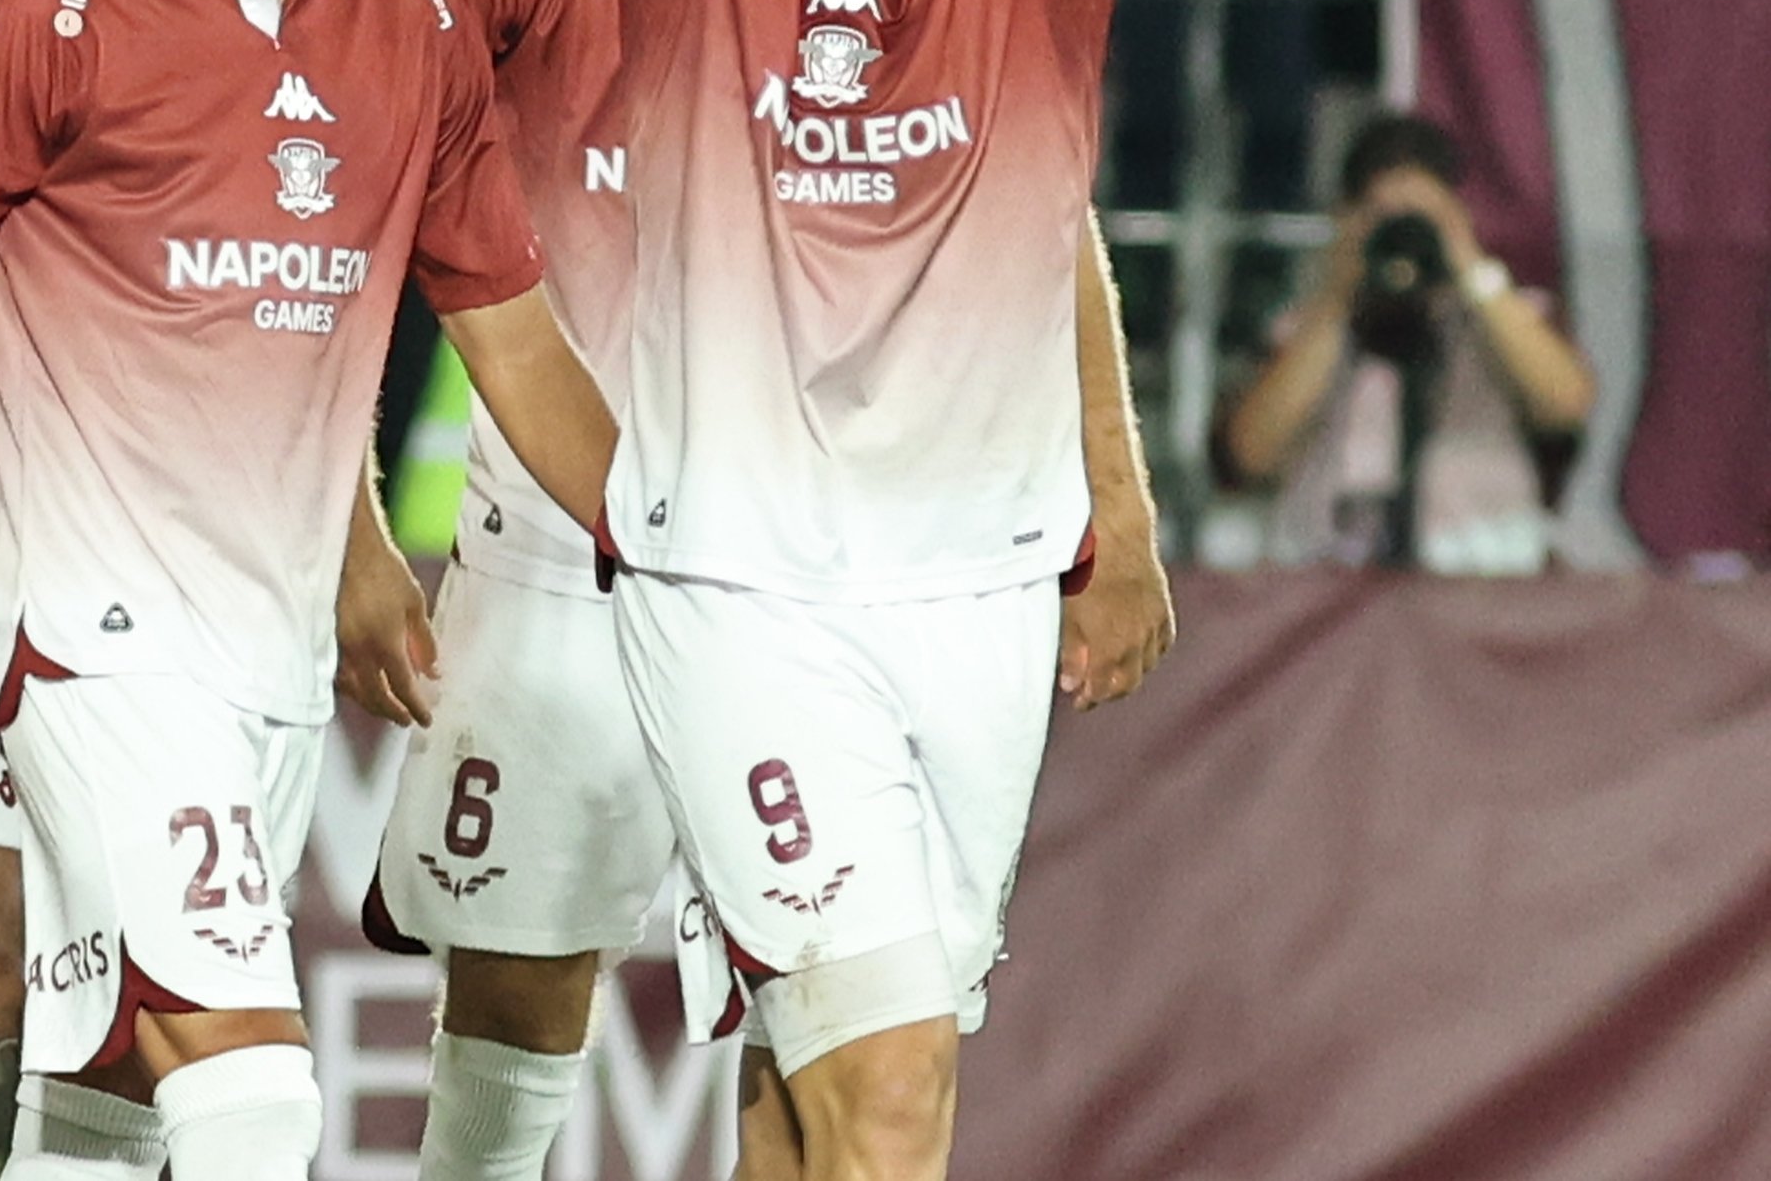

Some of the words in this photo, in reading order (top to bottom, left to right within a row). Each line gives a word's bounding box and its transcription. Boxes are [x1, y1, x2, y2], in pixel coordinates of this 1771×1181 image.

[774, 171, 897, 204] GAMES
[165, 237, 372, 294] NAPOLEON
[254, 299, 334, 334] GAMES
[444, 757, 500, 859] 6
[748, 758, 812, 864] 9
[169, 805, 269, 914] 23
